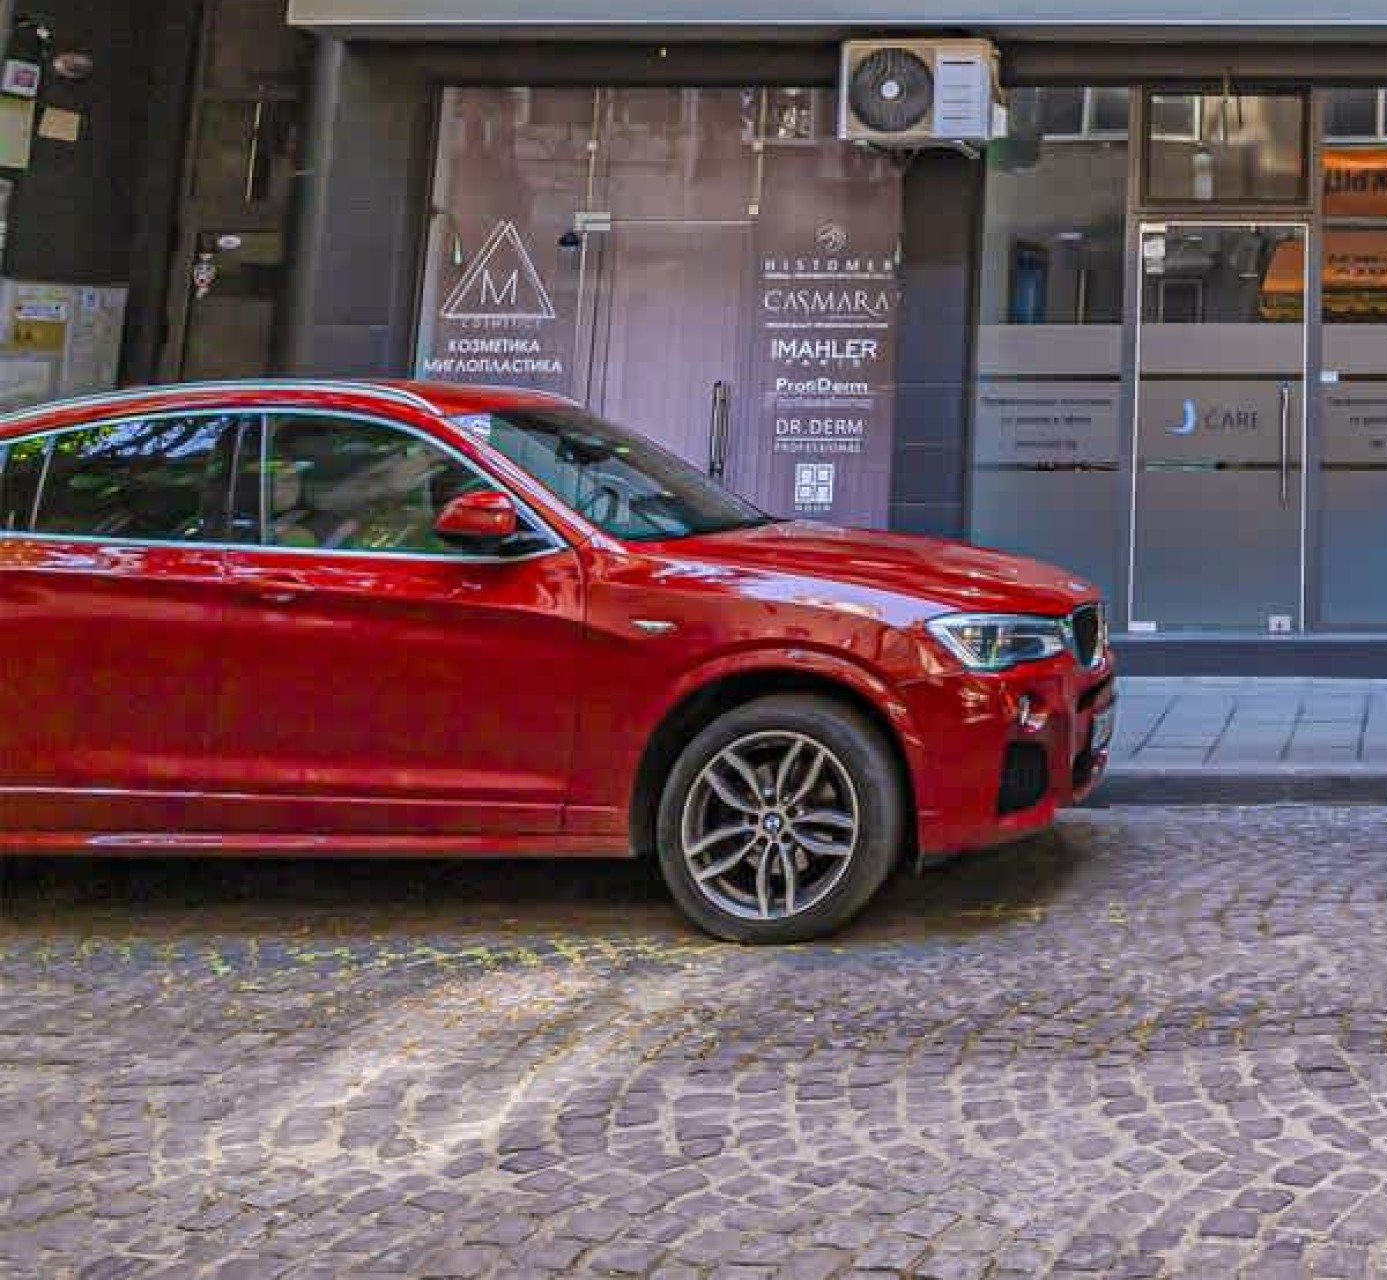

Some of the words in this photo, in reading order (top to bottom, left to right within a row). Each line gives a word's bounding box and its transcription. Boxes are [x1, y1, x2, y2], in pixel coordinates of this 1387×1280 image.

[480, 269, 519, 305] M
[764, 290, 889, 316] CASMARA
[448, 338, 541, 353] КОЗМЕТИКА
[424, 358, 563, 372] МИГЛОПЛАСТИКА
[1203, 409, 1258, 430] CARE
